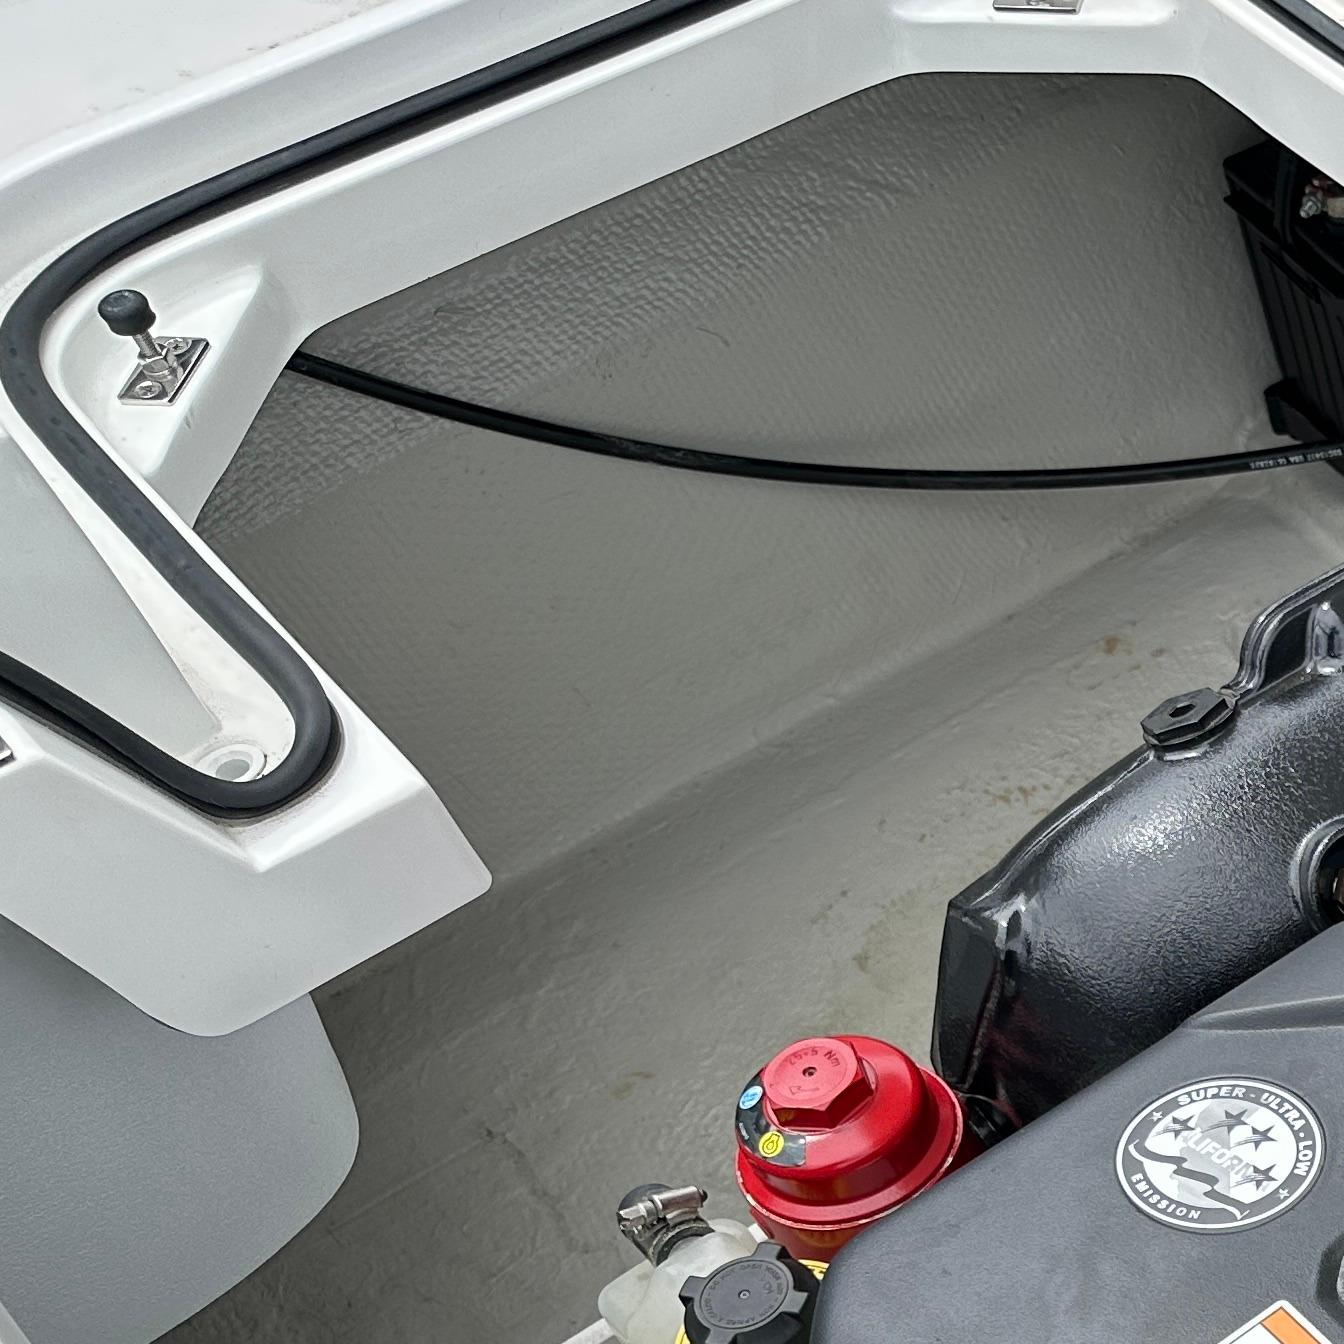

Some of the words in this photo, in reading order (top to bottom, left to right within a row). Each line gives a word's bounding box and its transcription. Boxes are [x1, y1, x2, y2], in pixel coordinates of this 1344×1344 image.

[1176, 1085, 1246, 1106] SUPER
[1259, 1091, 1306, 1131] ULTRA
[1293, 1140, 1313, 1176] LOW
[1130, 1172, 1201, 1219] EMISSION
